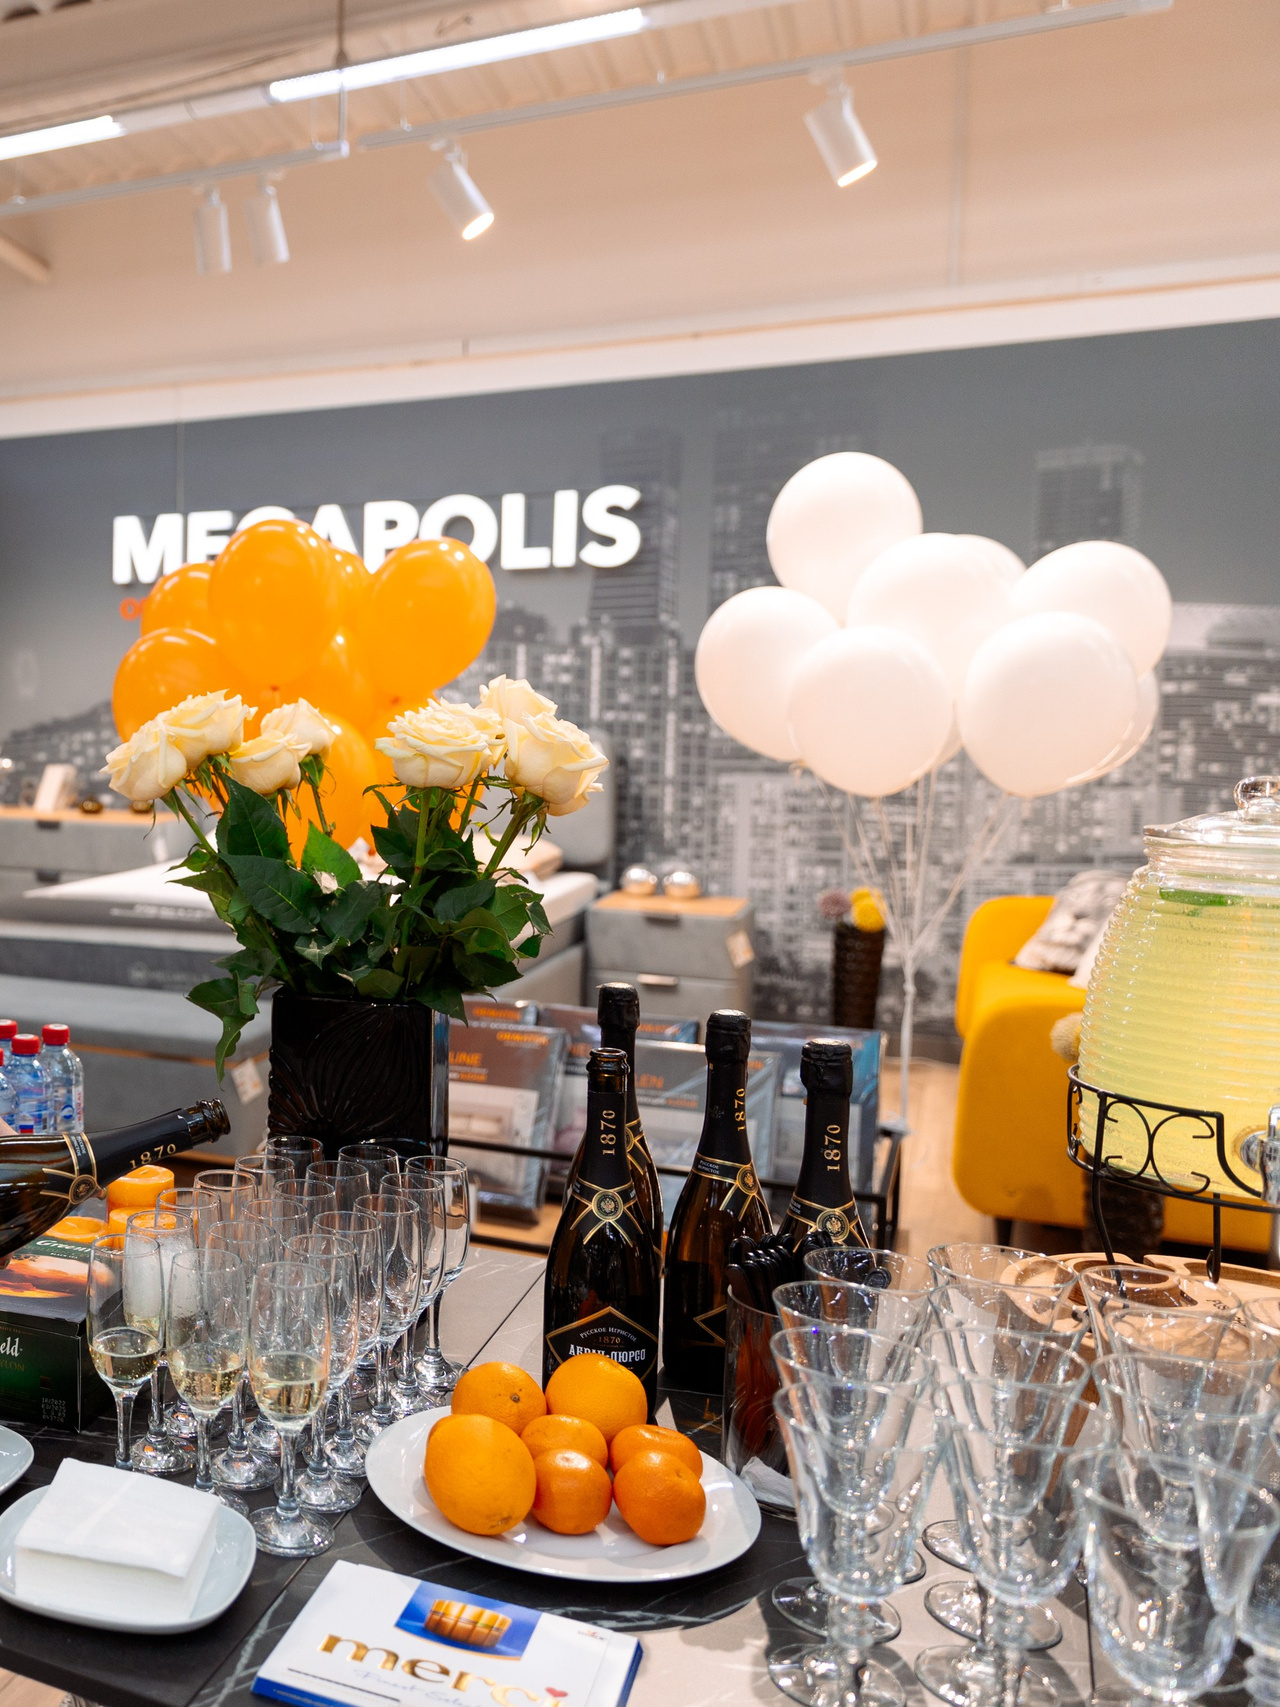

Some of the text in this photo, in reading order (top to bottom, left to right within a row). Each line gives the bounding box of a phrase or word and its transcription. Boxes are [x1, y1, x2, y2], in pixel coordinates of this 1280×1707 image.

[112, 484, 642, 586] MEAPOLIS
[734, 1087, 745, 1131] 1870
[600, 1109, 616, 1155] 1870
[823, 1124, 841, 1171] 1870
[129, 1143, 177, 1169] 1870
[580, 1327, 606, 1338] РУССКОЕ
[598, 1335, 621, 1343] 1870
